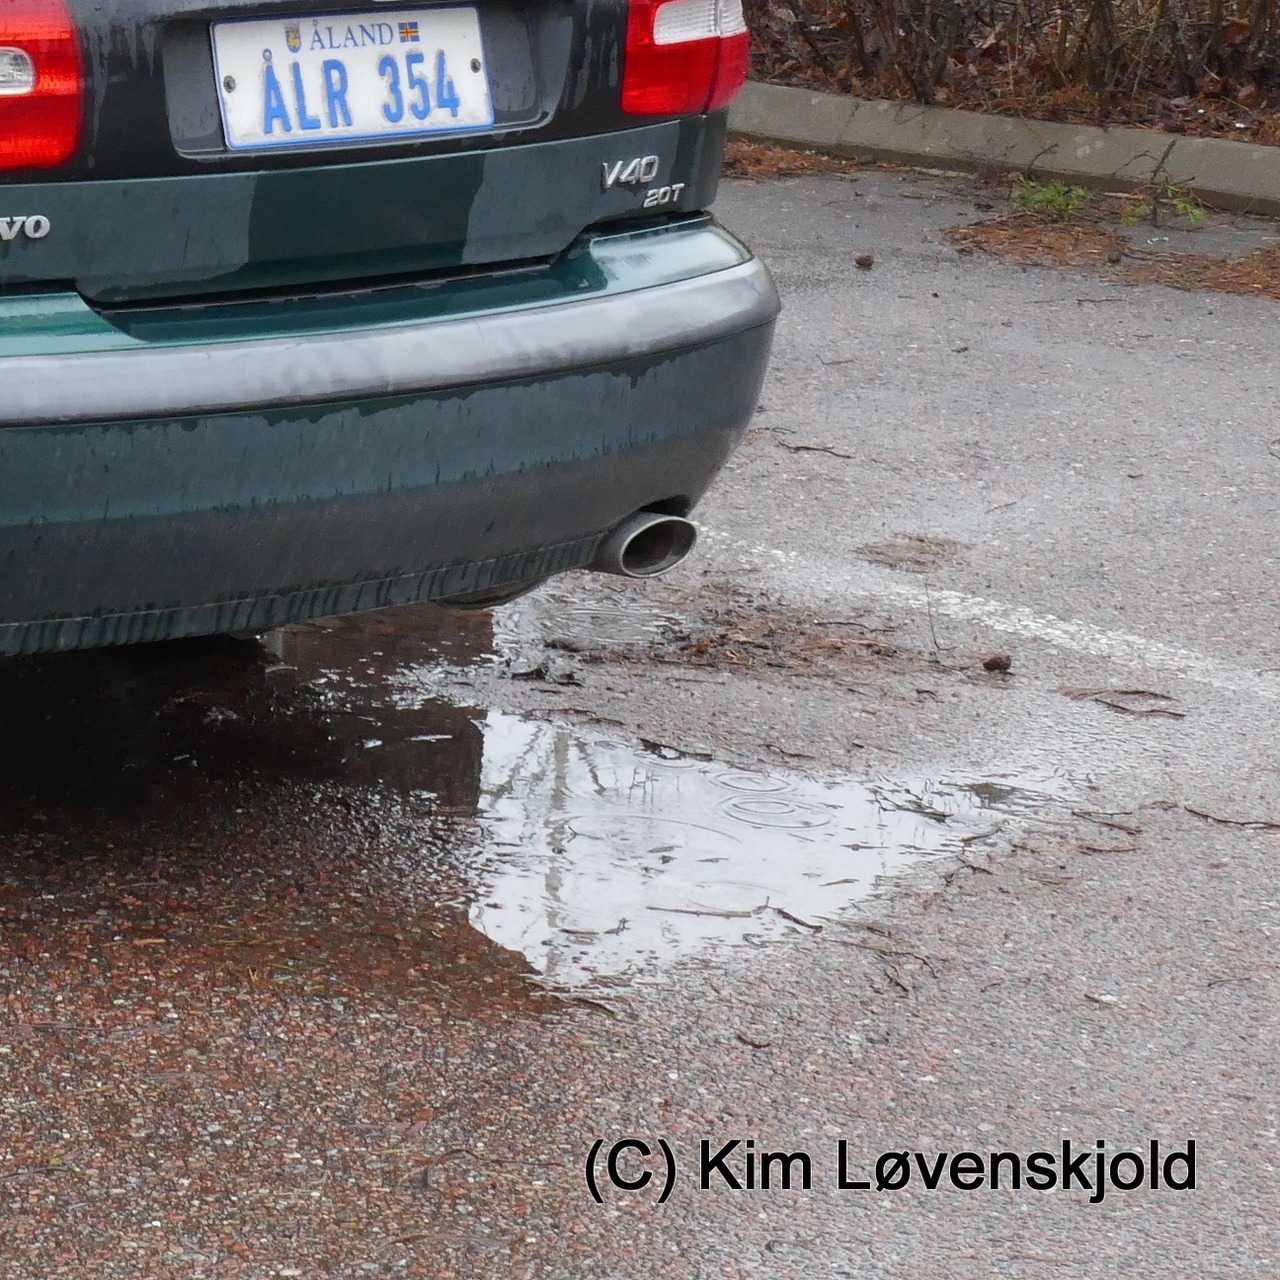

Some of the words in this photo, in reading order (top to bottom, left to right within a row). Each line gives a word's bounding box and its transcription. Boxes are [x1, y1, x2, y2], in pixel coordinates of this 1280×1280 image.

[309, 19, 394, 51] ÅLAND
[262, 47, 353, 134] ÅLR
[378, 49, 460, 122] 354
[602, 155, 659, 188] V40
